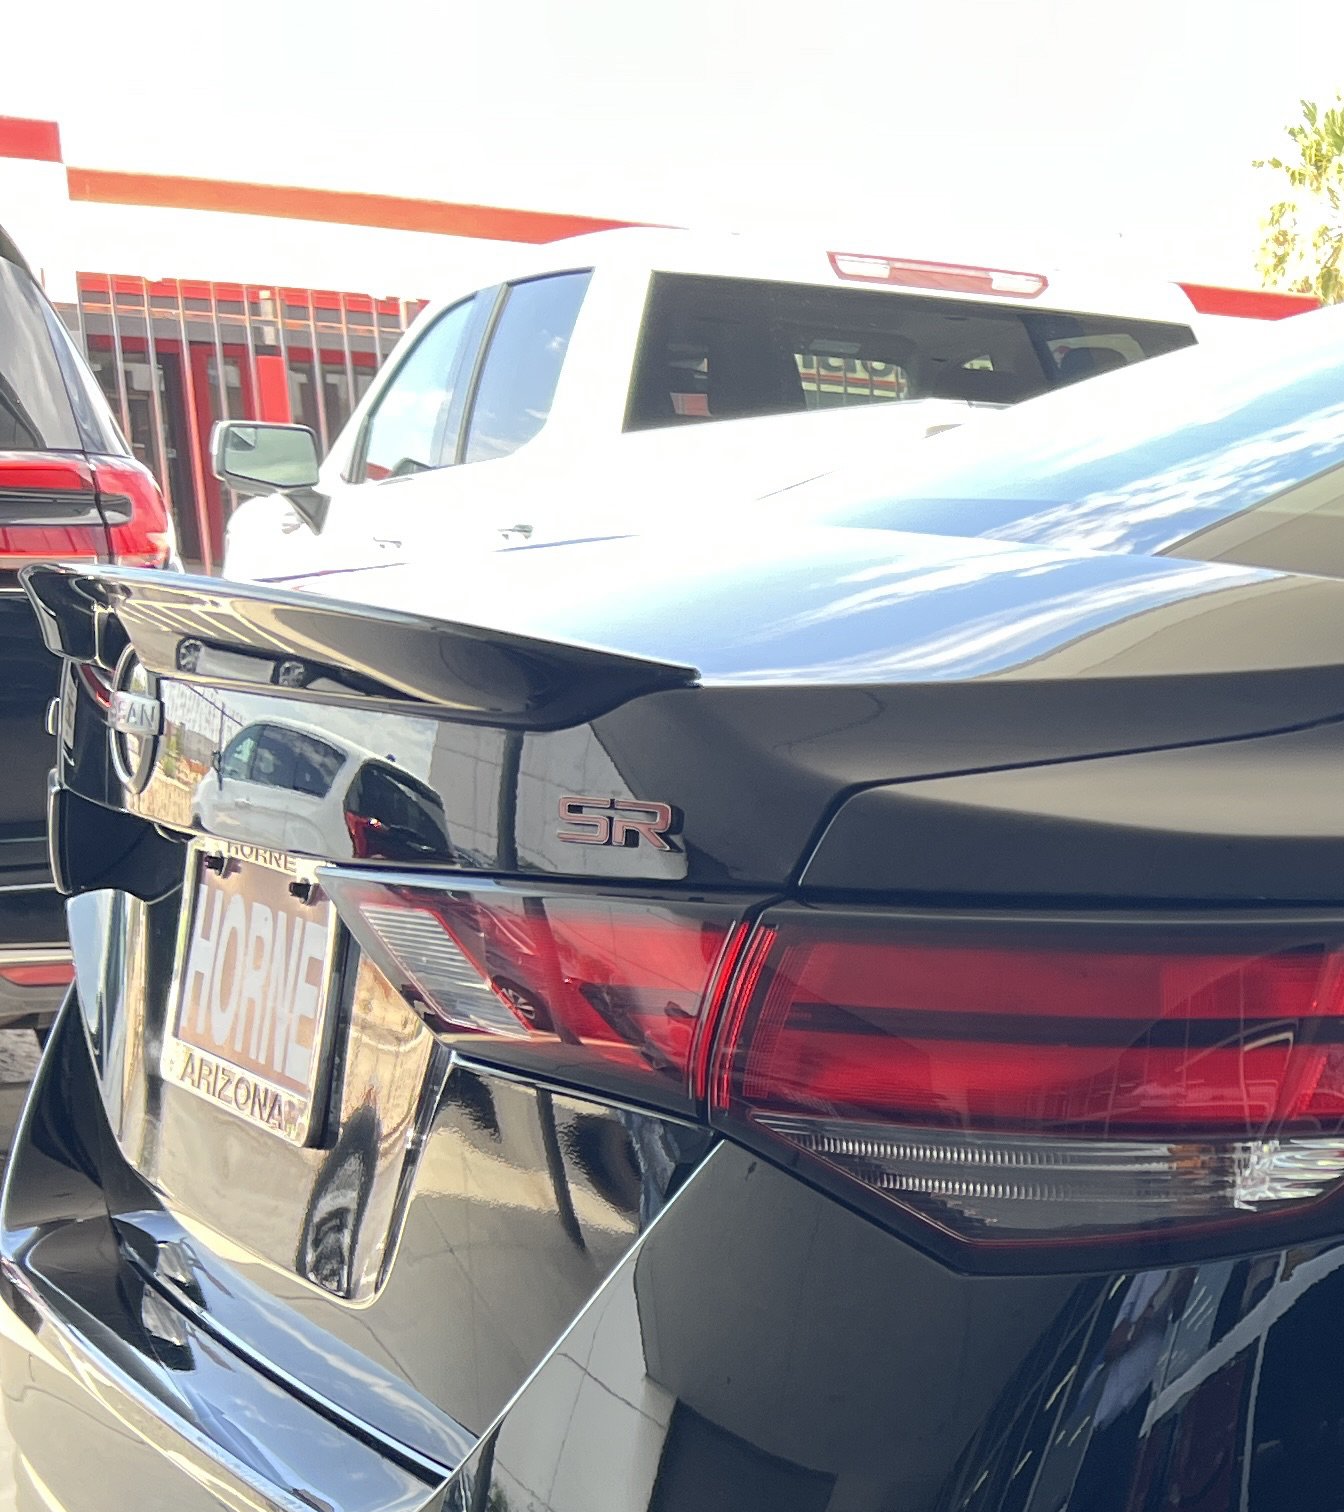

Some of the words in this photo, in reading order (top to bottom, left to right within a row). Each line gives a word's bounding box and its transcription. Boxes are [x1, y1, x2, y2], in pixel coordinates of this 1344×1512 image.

[557, 797, 671, 850] SR
[181, 884, 328, 1086] HORNE
[180, 1052, 288, 1132] ARIZONA
